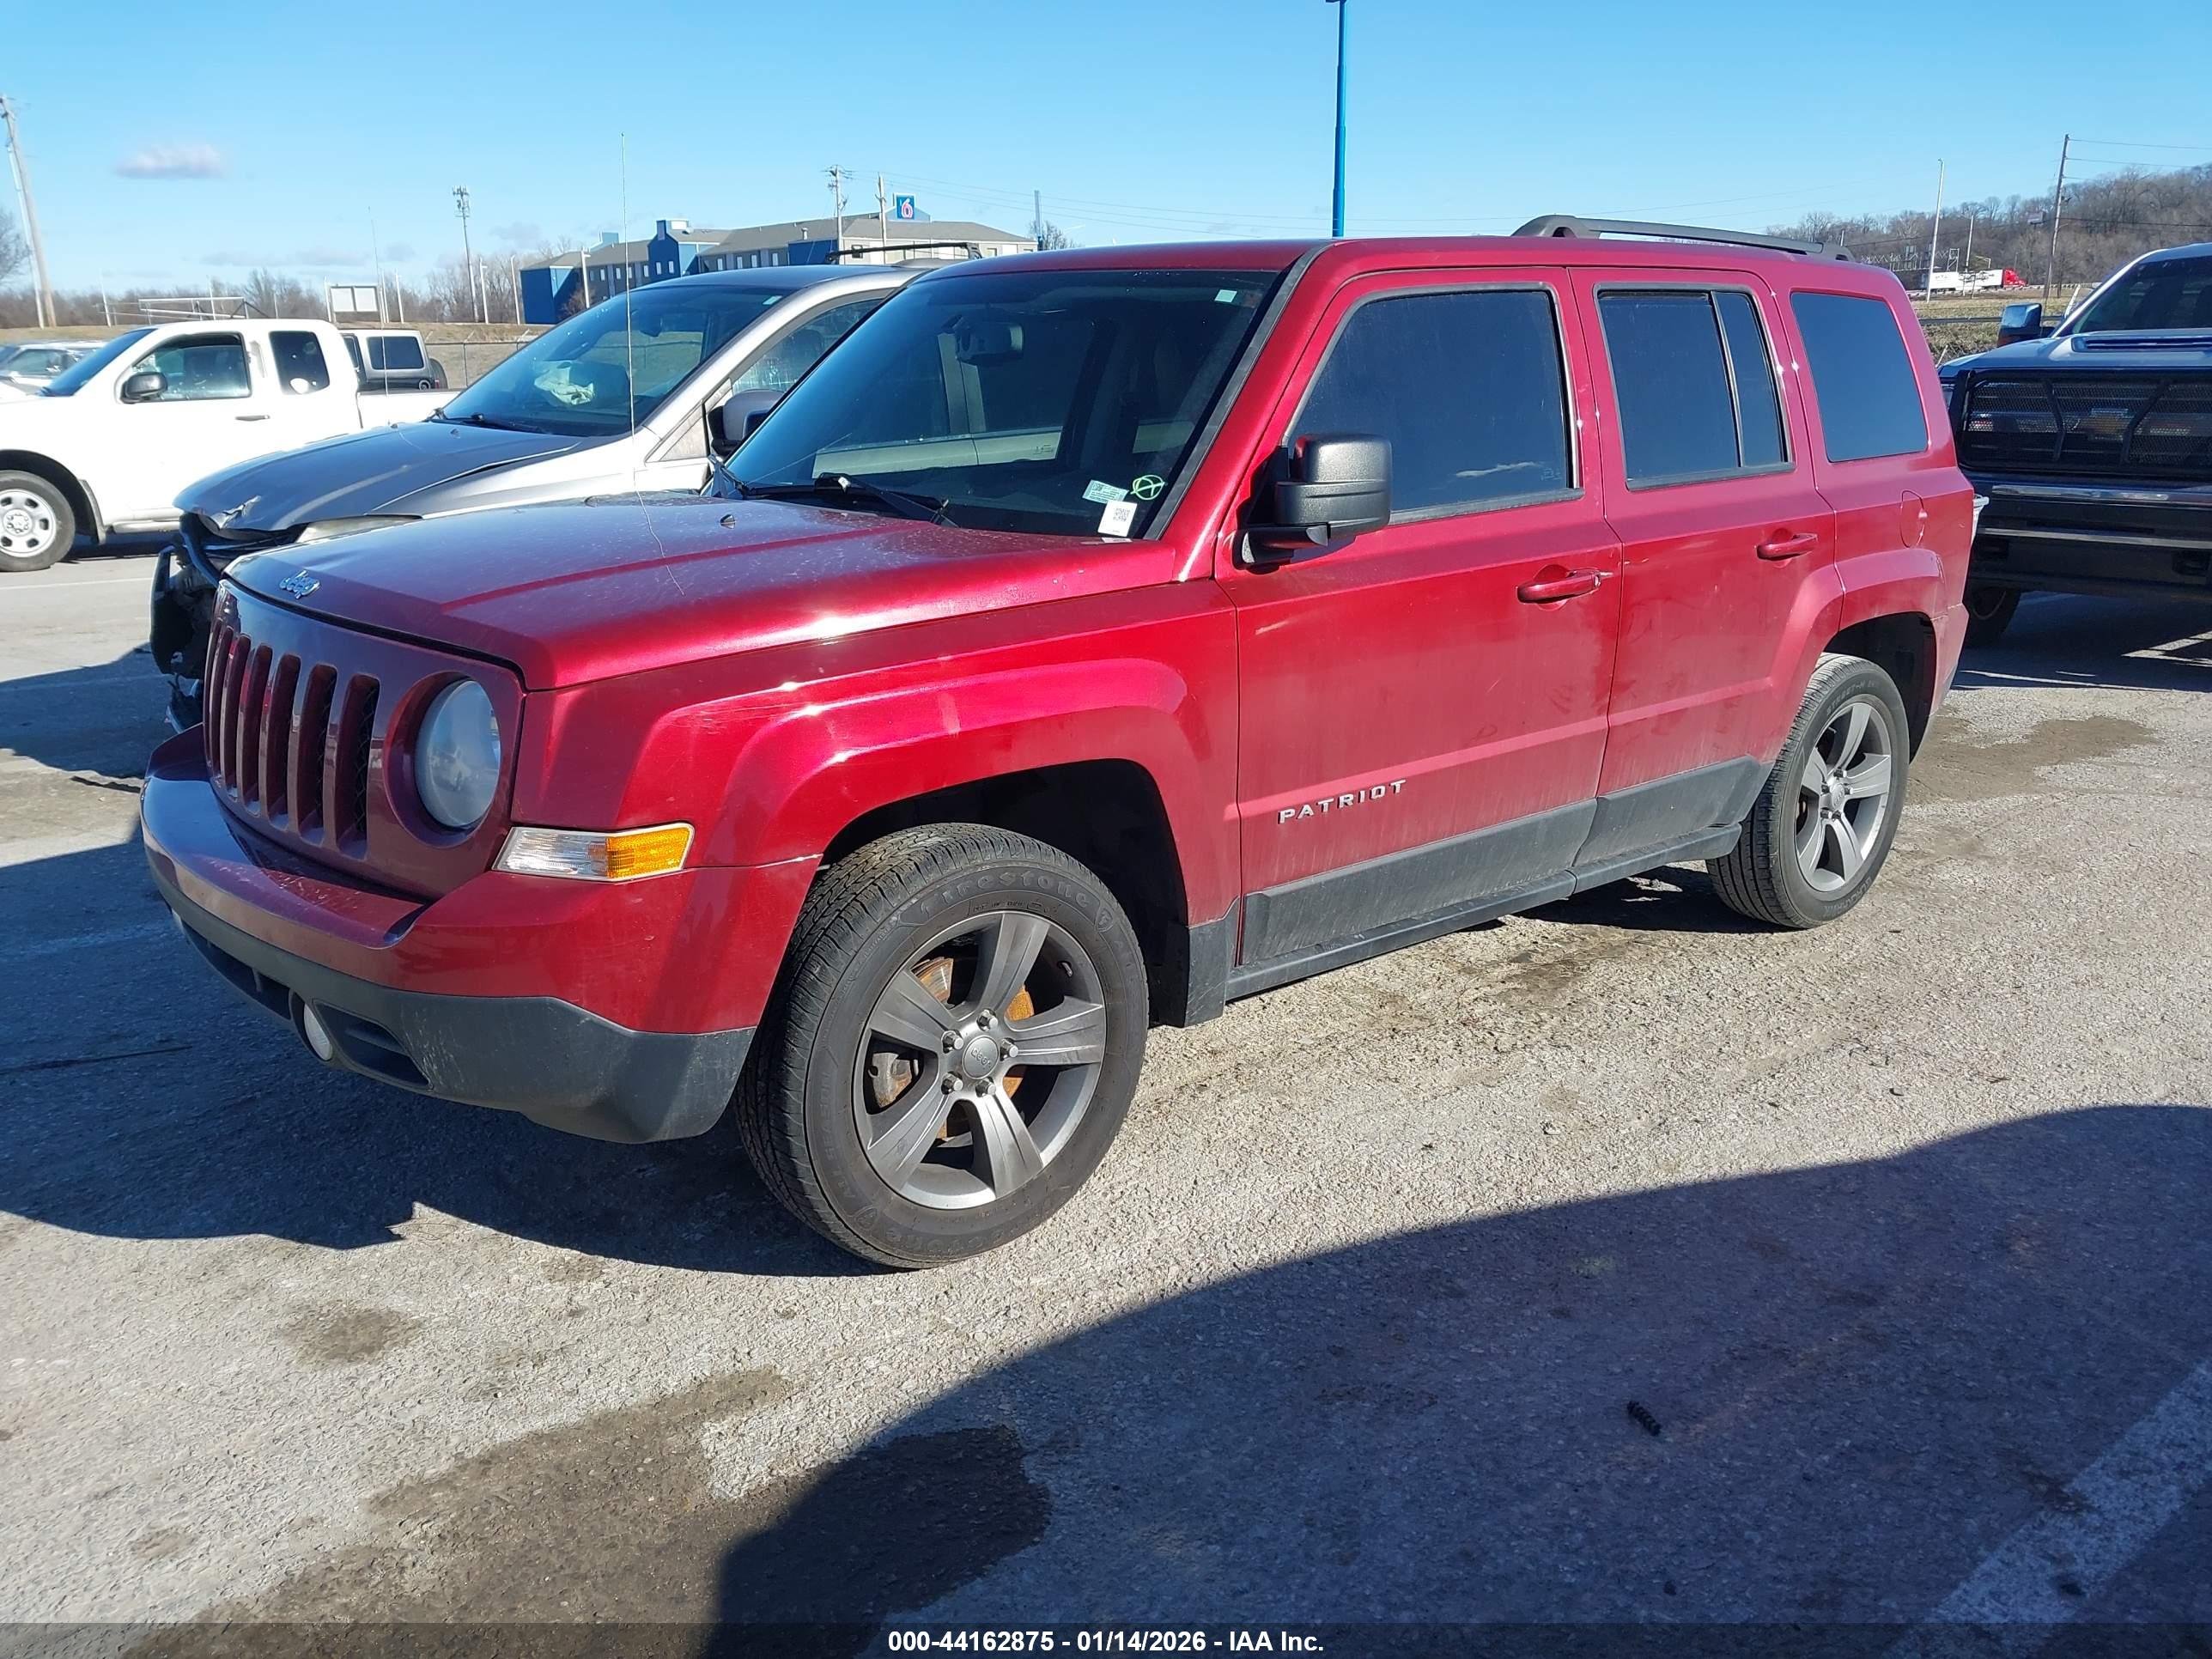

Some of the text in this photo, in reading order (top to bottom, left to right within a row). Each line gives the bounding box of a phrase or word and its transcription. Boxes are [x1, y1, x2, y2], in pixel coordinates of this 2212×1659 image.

[902, 198, 914, 219] 6
[279, 568, 320, 599] Jeep
[1277, 779, 1407, 824] PATRIOT
[920, 870, 1089, 917] Firestone
